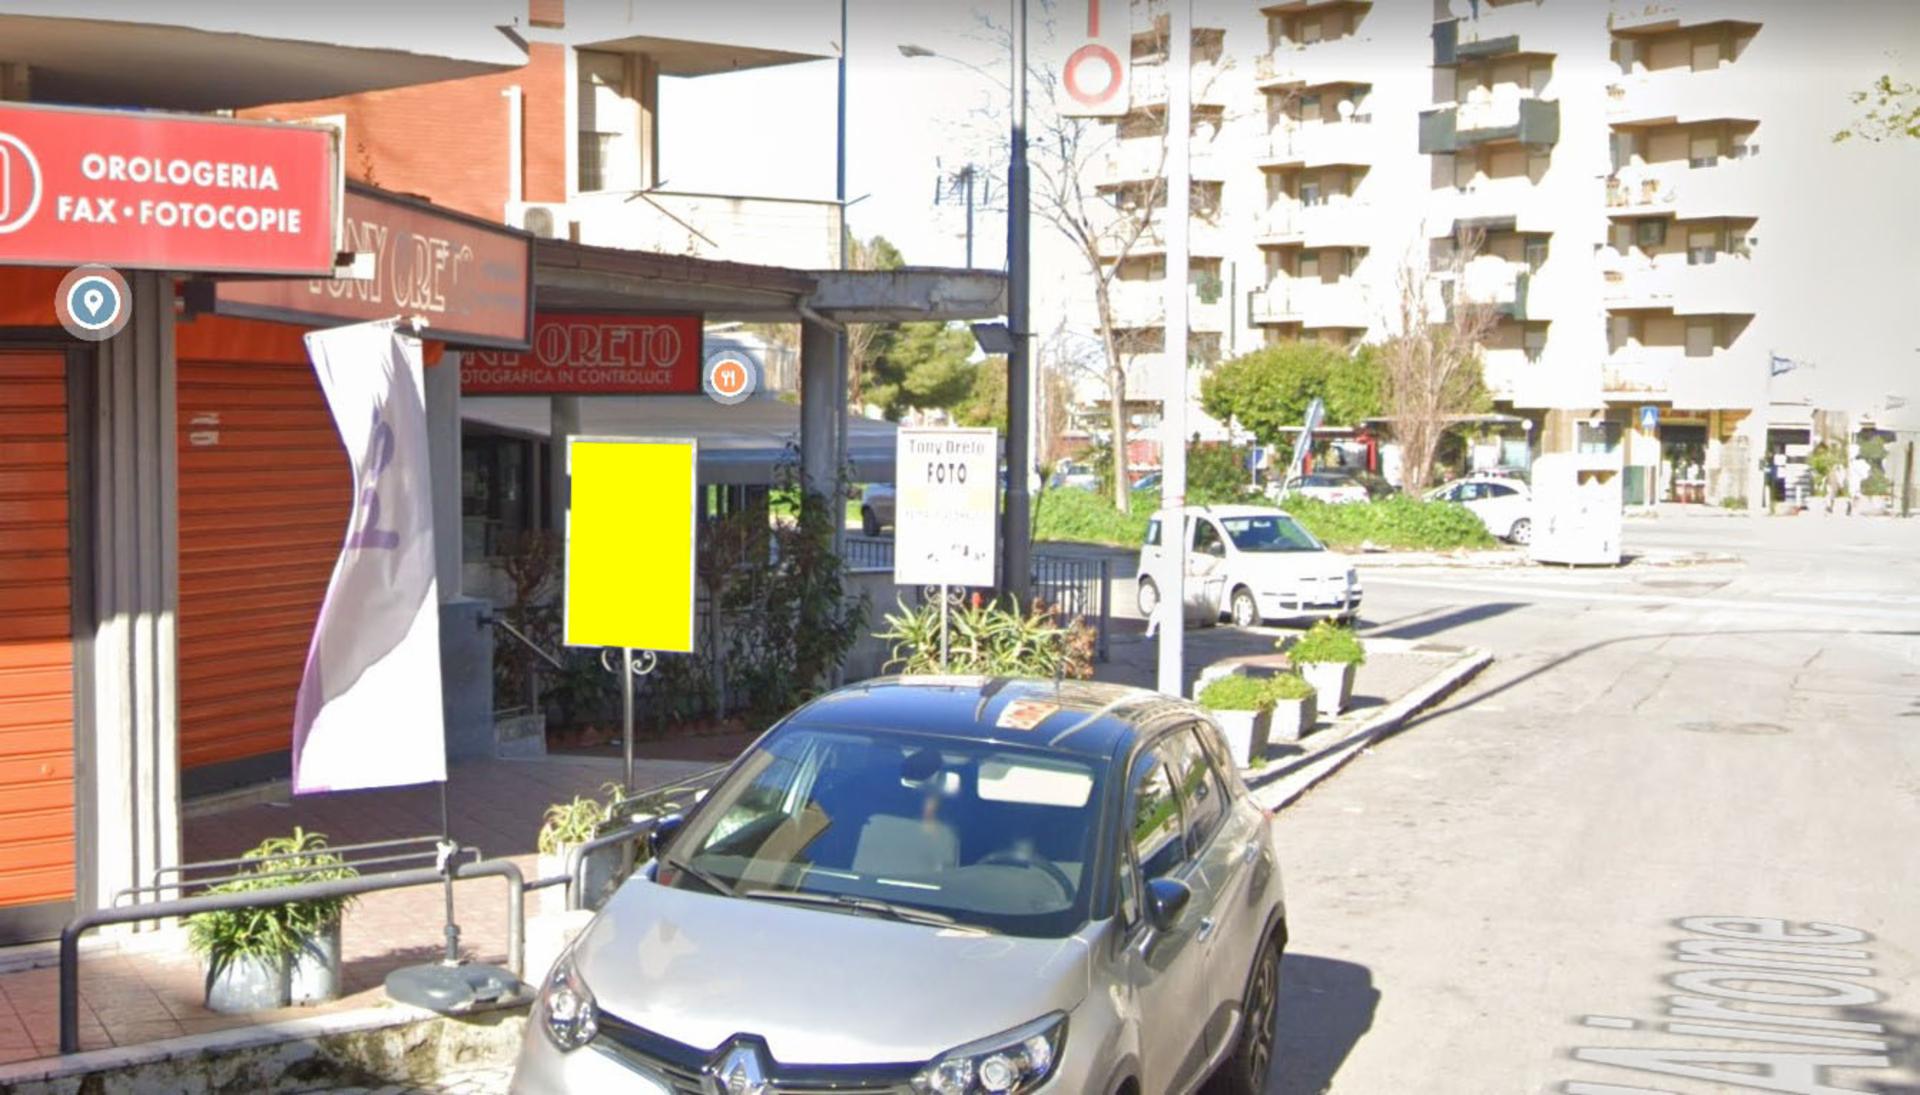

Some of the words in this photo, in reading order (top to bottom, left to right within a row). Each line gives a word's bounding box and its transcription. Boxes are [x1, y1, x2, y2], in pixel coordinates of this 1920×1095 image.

[81, 153, 279, 191] OROLOGERIA
[57, 196, 117, 224] FAX
[139, 200, 301, 233] FOTOCOPIE
[536, 323, 681, 368] ORETO
[459, 369, 551, 385] OTOGRAFICA
[558, 370, 573, 384] IN
[577, 370, 673, 385] CONTROLUCE
[909, 439, 943, 456] Tony
[927, 461, 967, 484] FOTO
